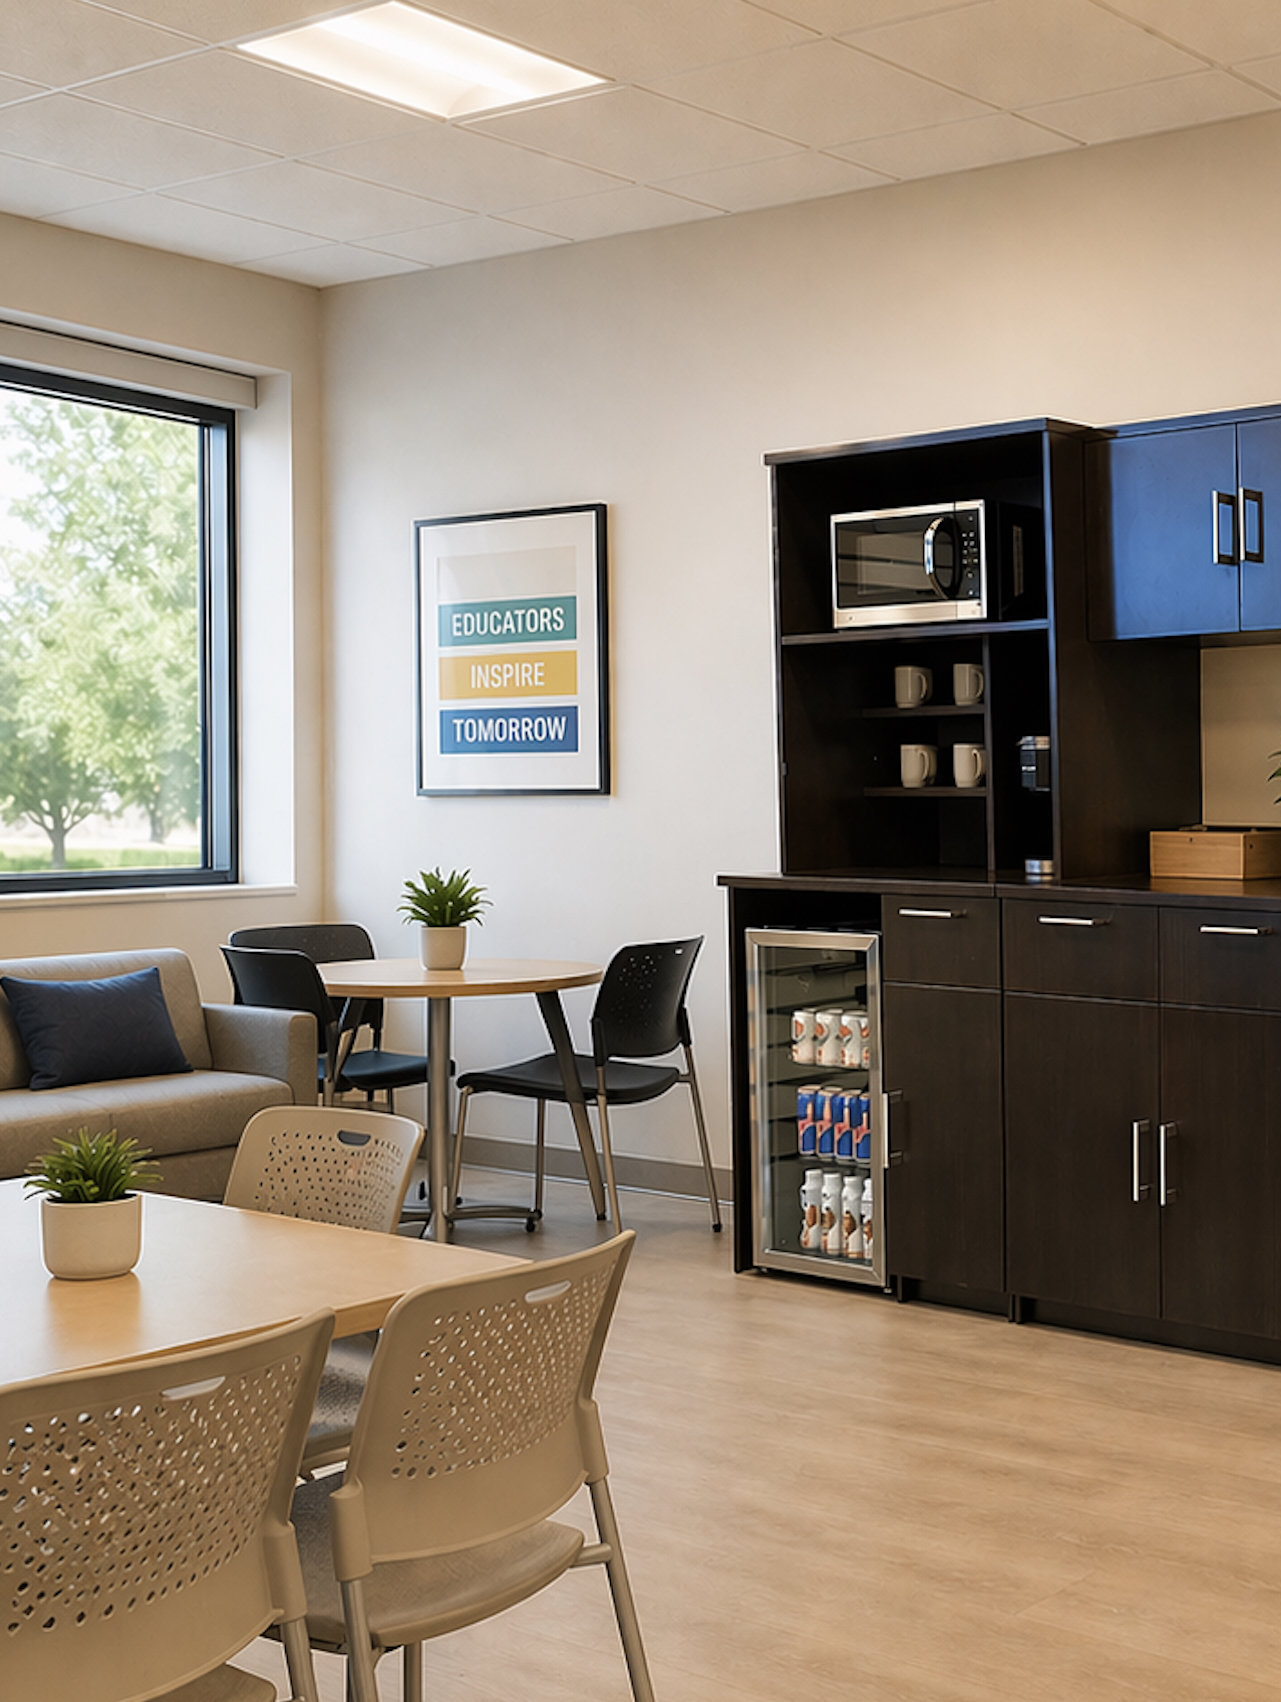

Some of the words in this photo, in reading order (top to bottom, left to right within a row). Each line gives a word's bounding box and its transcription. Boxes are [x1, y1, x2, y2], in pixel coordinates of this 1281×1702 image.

[453, 607, 565, 637] EDUCATORS
[471, 662, 545, 689] INSPIRE
[453, 716, 567, 743] TOMORROW
